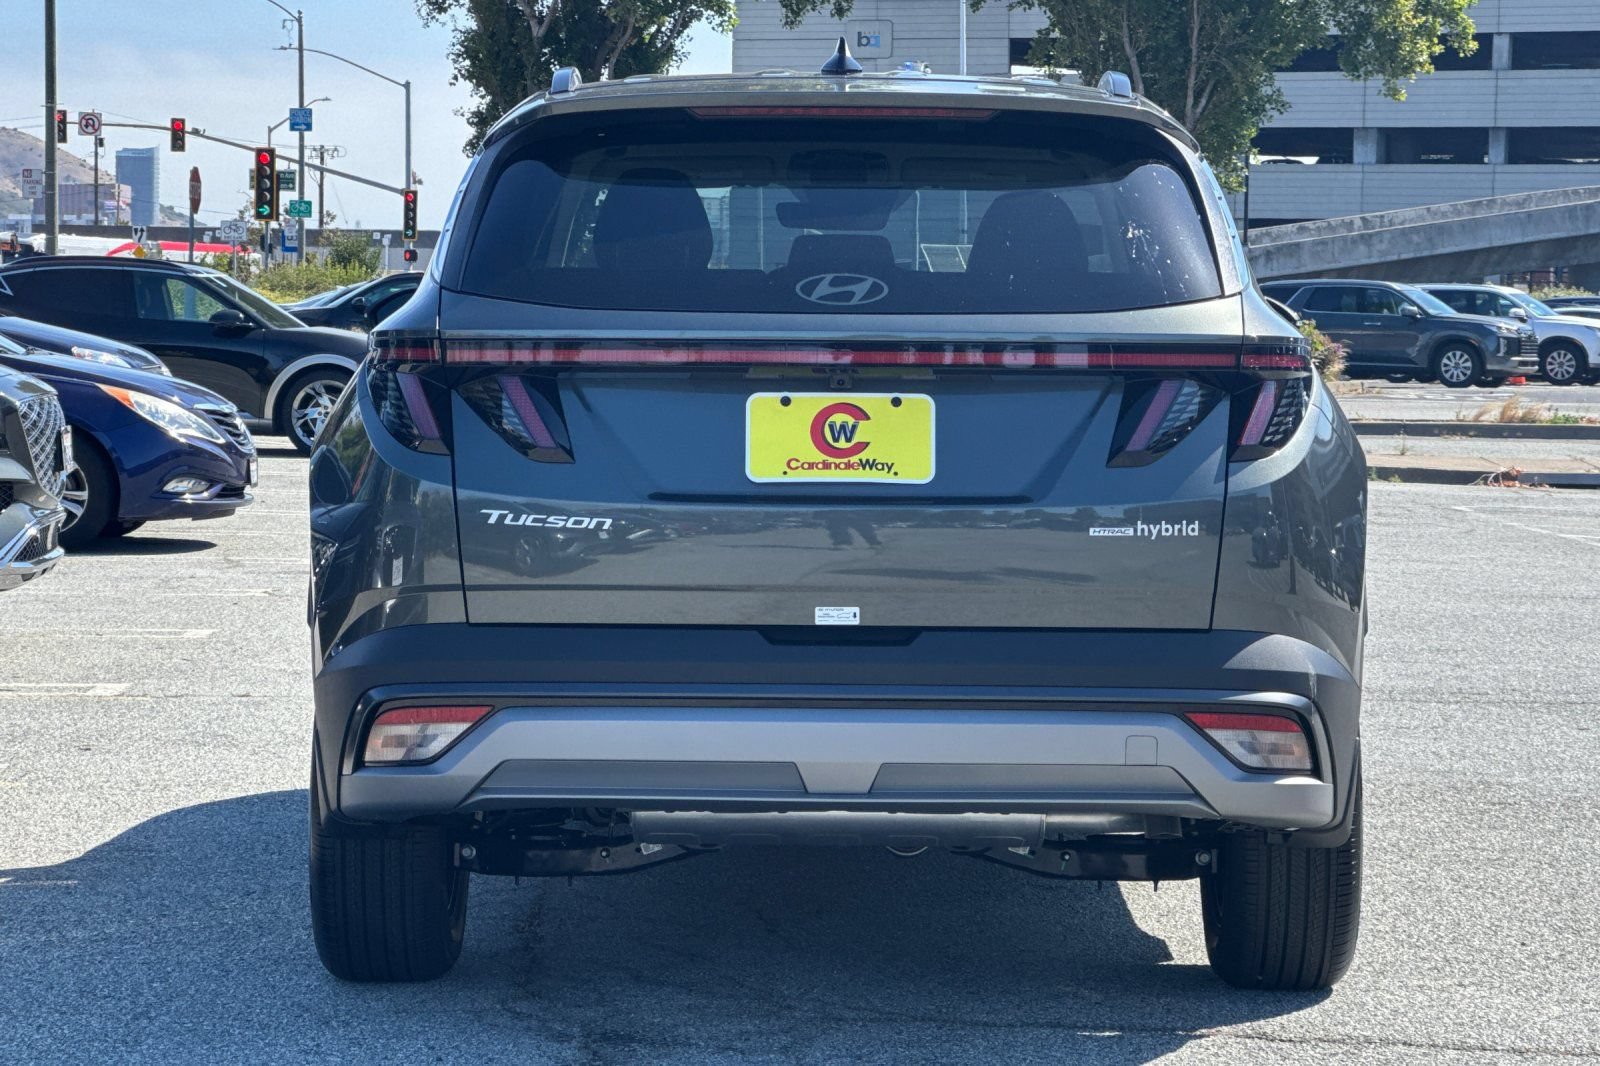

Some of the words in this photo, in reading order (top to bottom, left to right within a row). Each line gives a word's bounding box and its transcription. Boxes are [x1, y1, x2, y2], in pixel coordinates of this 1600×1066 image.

[24, 170, 32, 178] NO
[786, 458, 895, 474] CardinaleWay
[1090, 528, 1133, 536] HTRAC
[1137, 520, 1199, 540] hybrid
